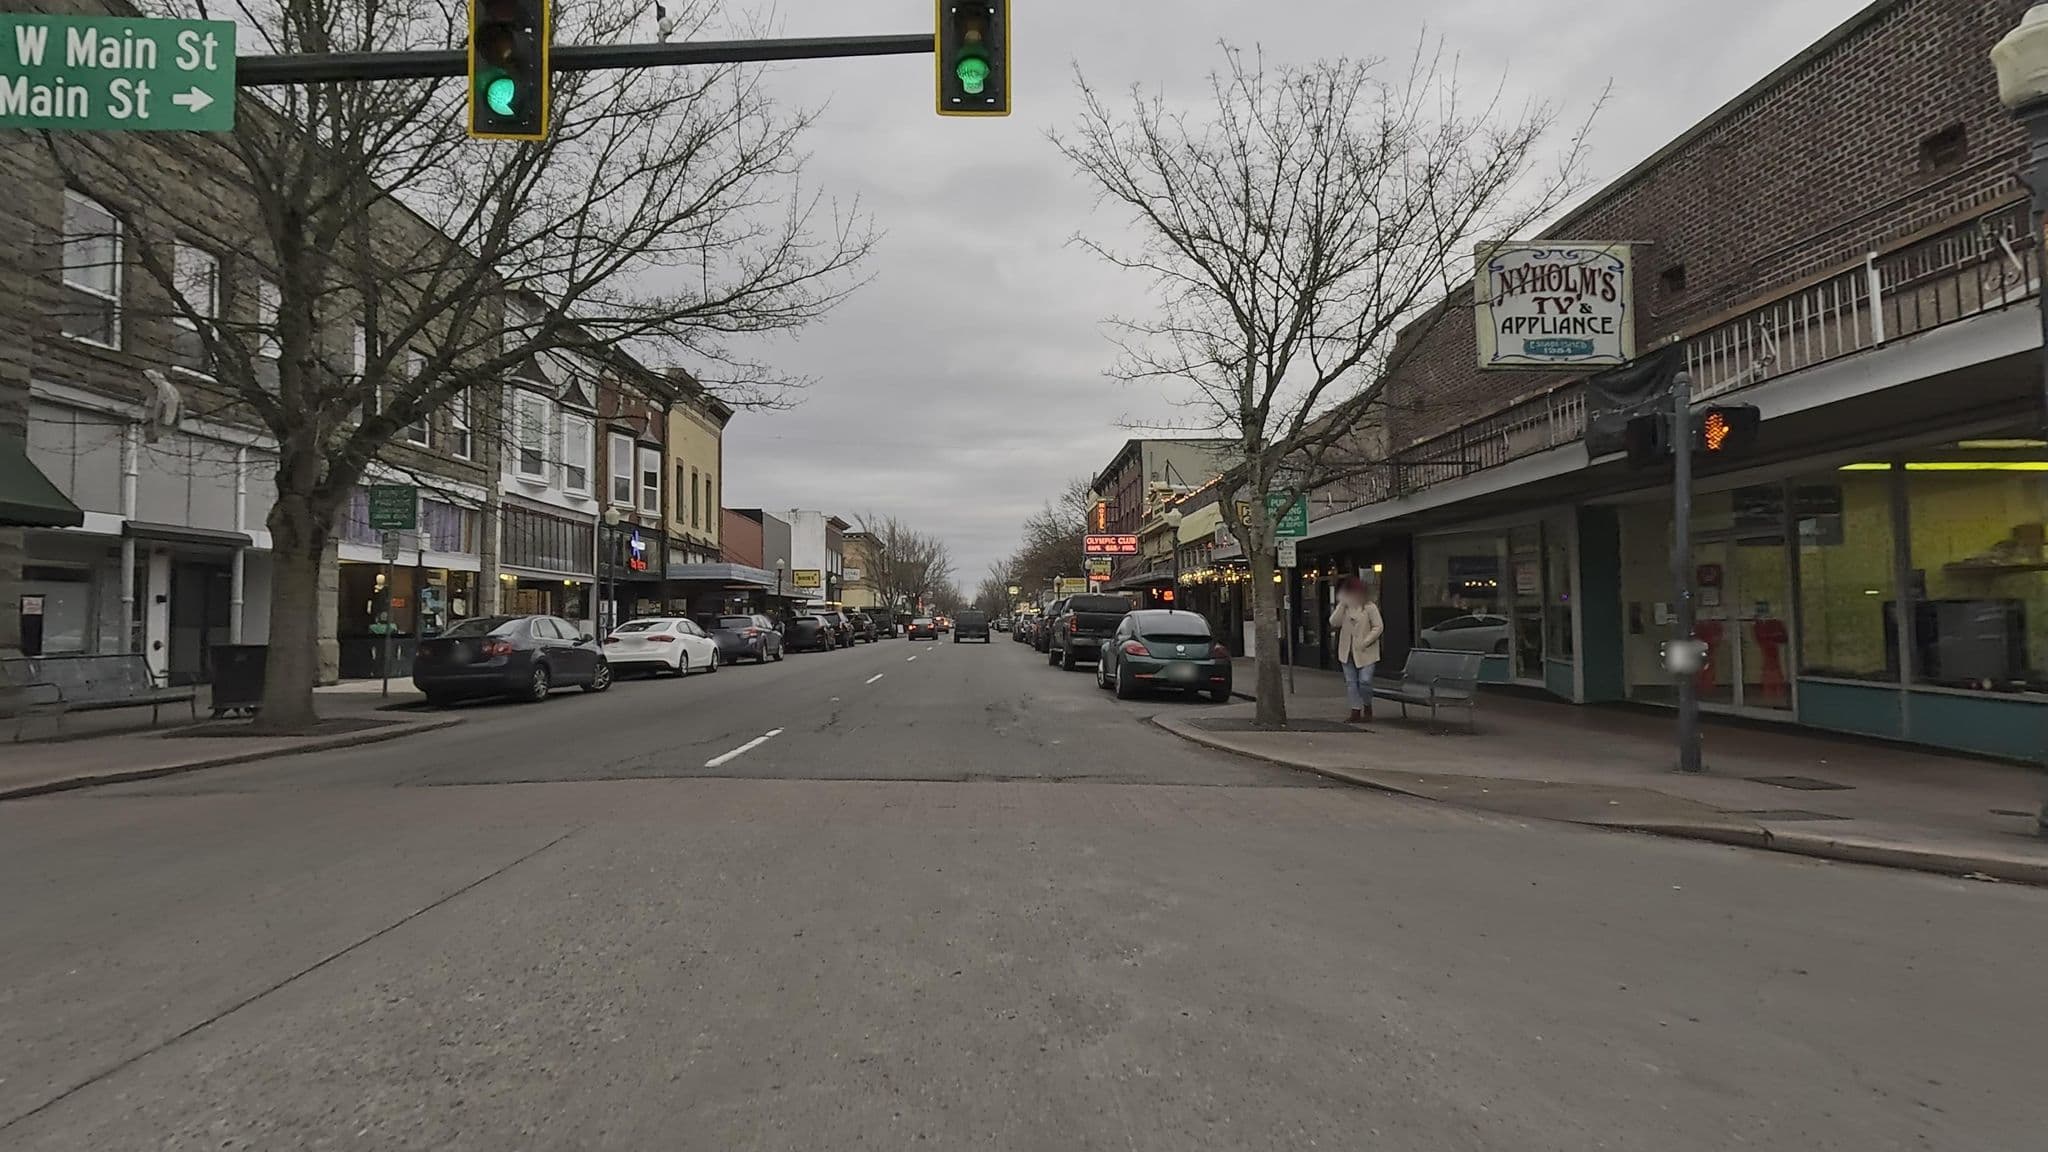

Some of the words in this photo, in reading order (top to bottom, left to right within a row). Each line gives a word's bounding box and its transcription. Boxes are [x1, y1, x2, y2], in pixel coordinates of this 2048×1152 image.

[15, 25, 48, 66] W
[66, 27, 157, 70] Main
[176, 29, 219, 72] St
[0, 75, 89, 118] Main
[107, 77, 151, 120] St
[1498, 262, 1616, 306] NYHOLM'S
[1532, 297, 1575, 315] TV
[1579, 303, 1593, 314] &
[1501, 316, 1615, 335] APPLIANCE
[1086, 537, 1116, 545] OLYMPIC
[1117, 537, 1136, 545] CLUB
